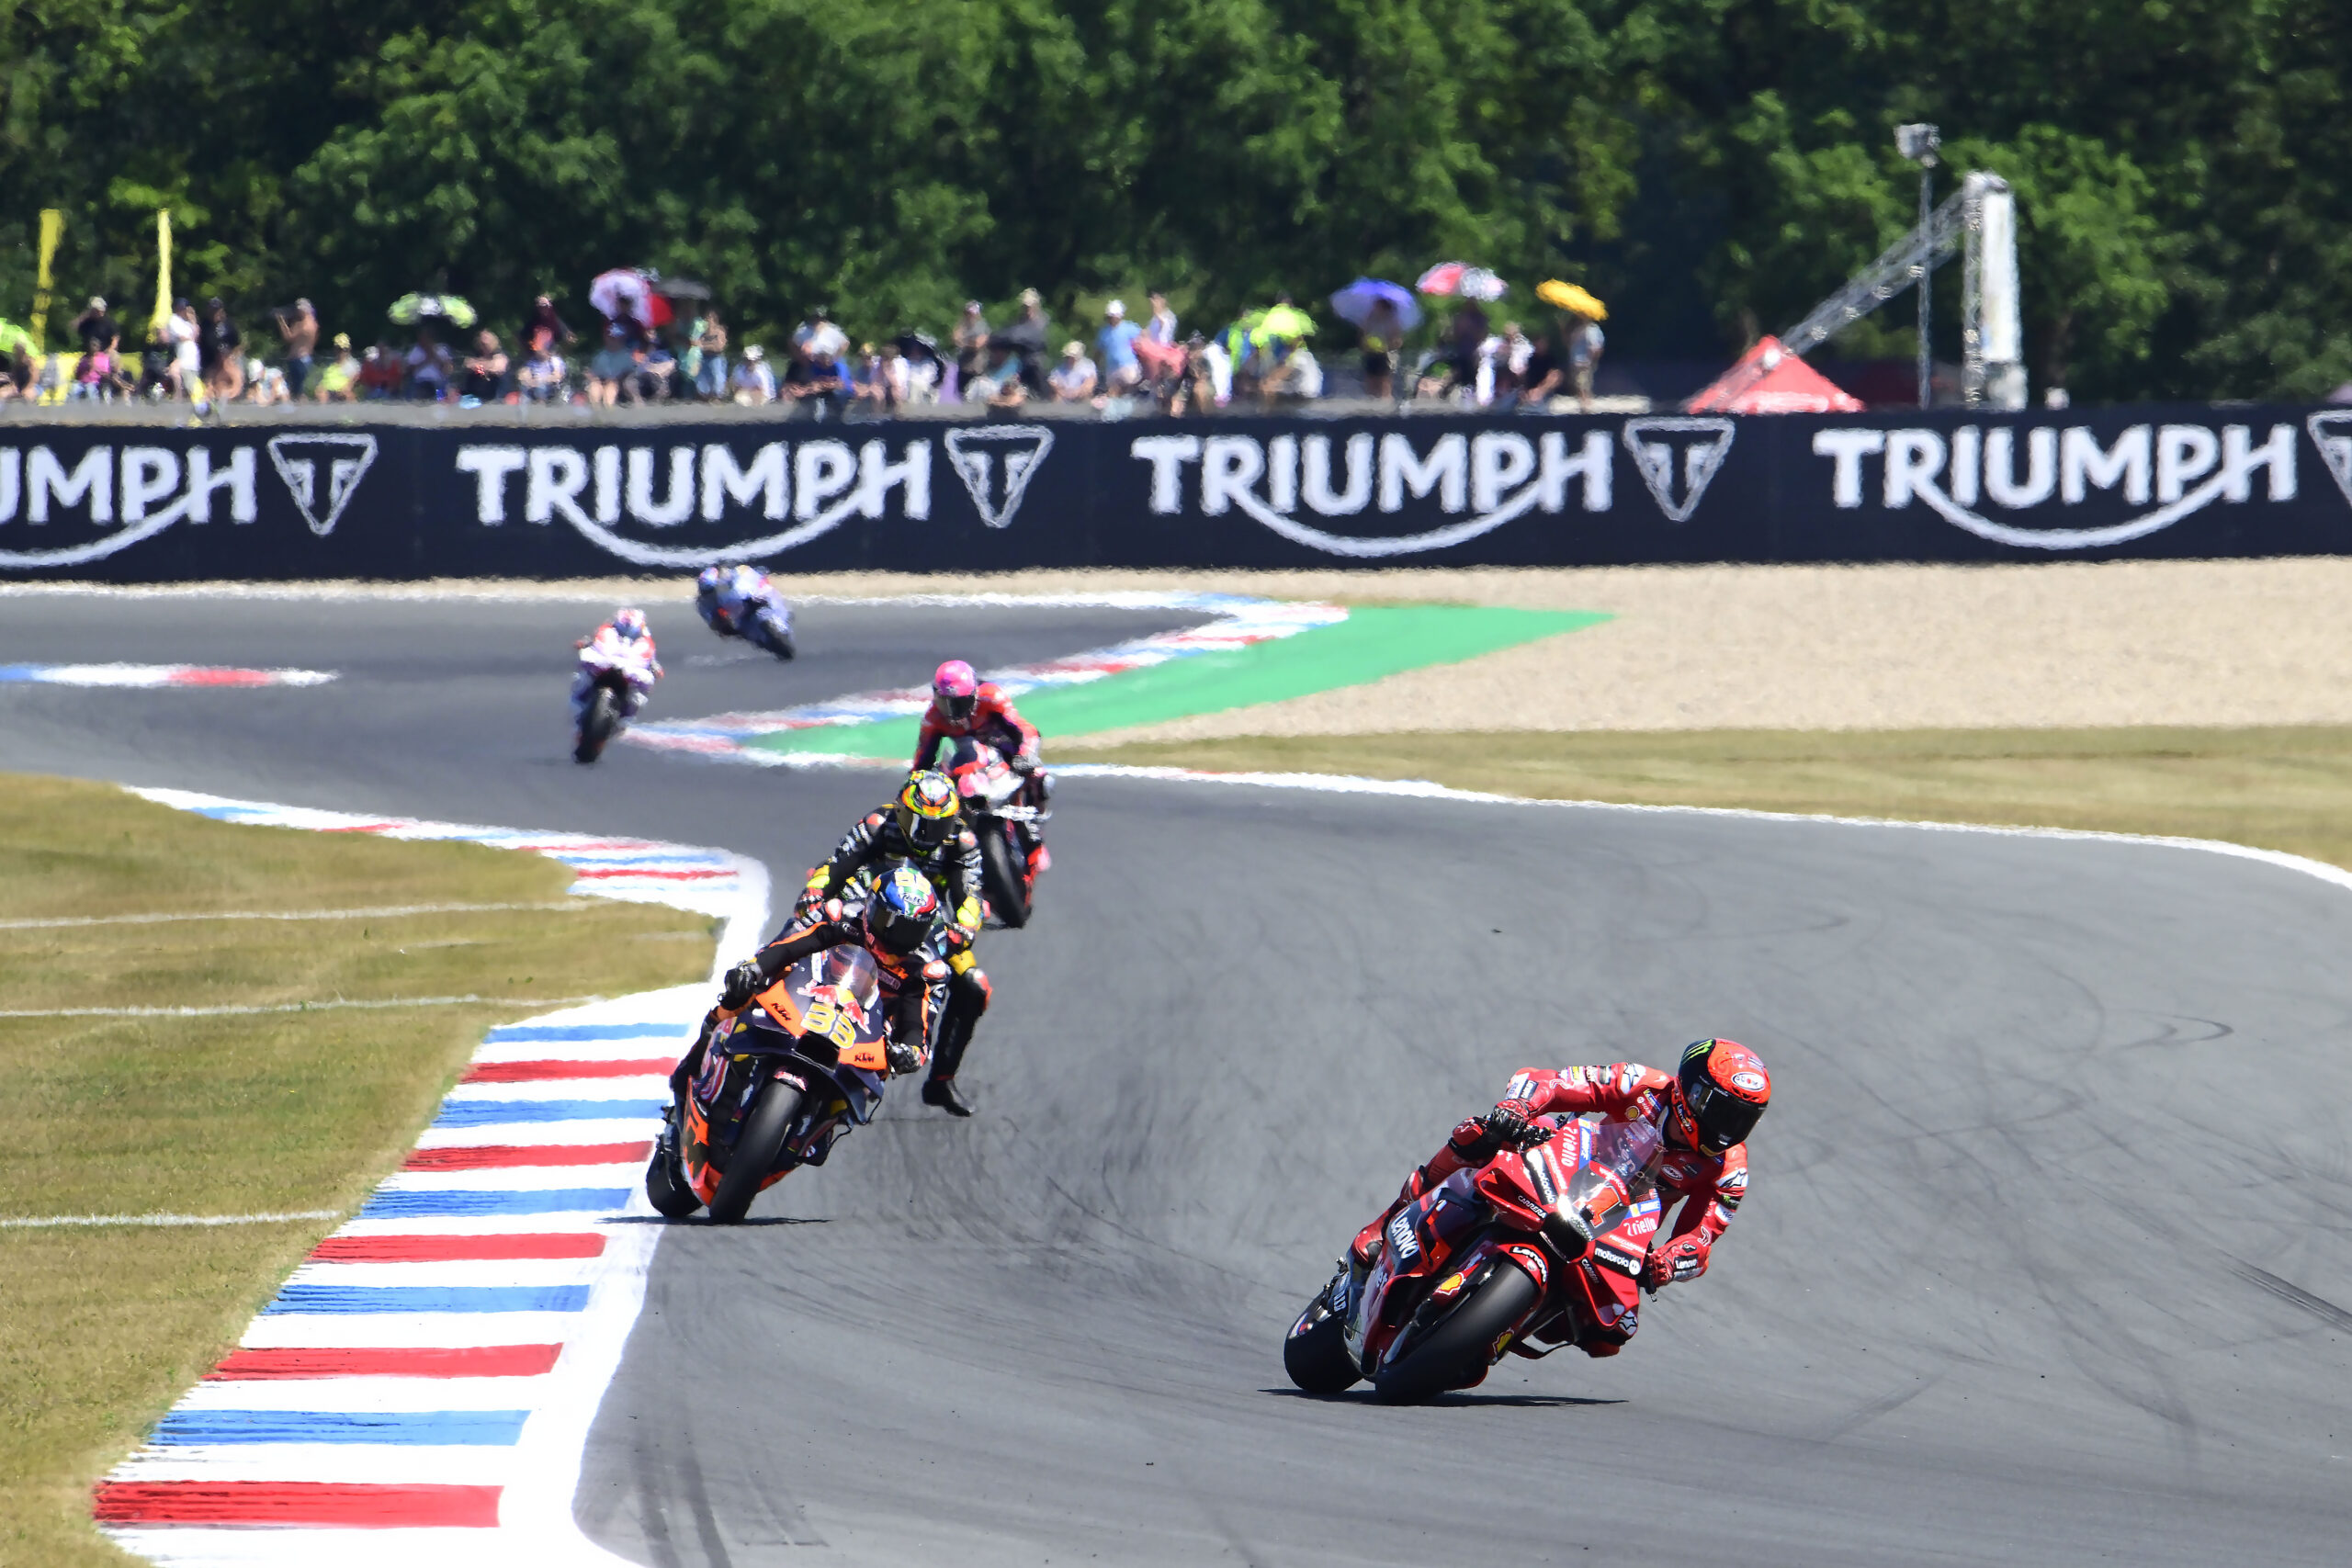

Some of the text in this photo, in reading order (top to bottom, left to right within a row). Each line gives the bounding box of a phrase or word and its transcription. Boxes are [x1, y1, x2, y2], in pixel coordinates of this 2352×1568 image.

[0, 445, 258, 568] MPH
[455, 439, 932, 569] TRIUMPH
[1131, 431, 1612, 557] TRIUMPH
[1812, 423, 2298, 549] TRIUMPH
[1389, 1207, 1419, 1259] Lenovo
[1517, 1195, 1548, 1219] CARRERA
[1512, 1247, 1548, 1283] Lenovo
[1594, 1247, 1629, 1268] motorola
[1675, 1258, 1698, 1269] Lenovo
